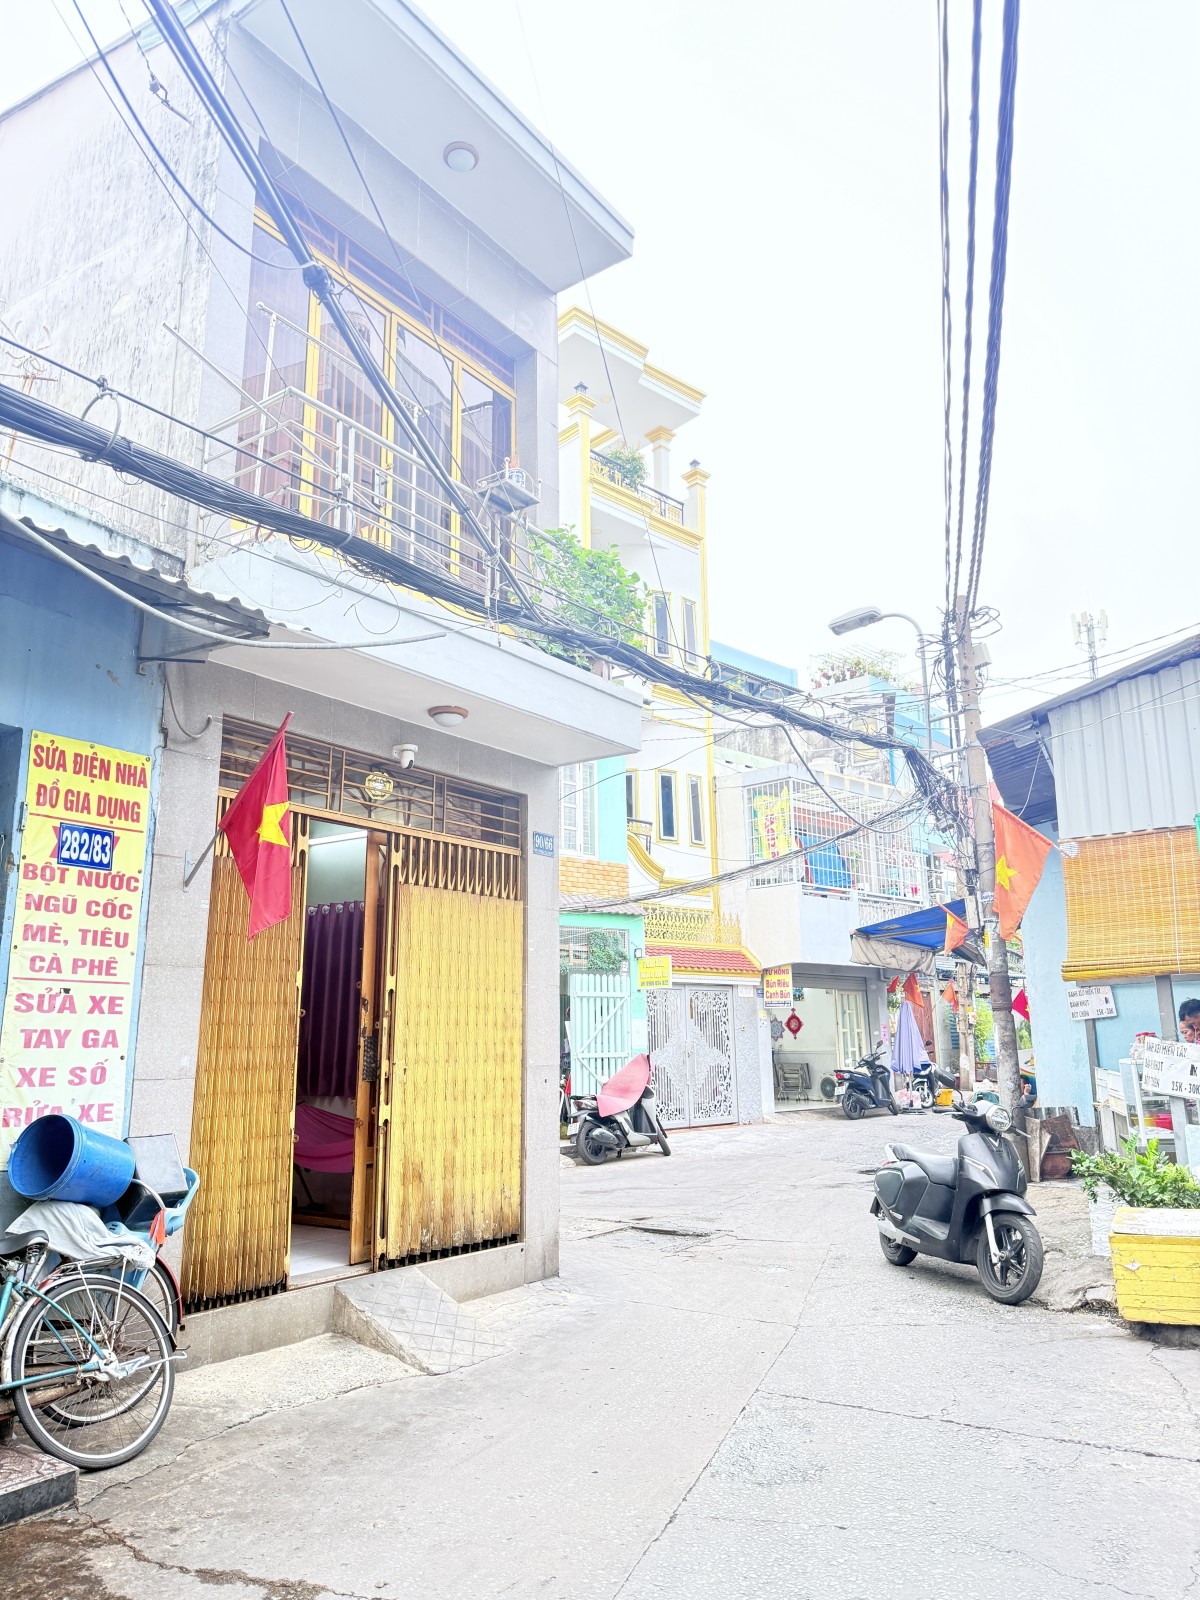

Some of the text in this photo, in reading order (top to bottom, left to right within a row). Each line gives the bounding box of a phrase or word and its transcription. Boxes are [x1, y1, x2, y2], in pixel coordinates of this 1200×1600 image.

[33, 740, 147, 788] SỬA ĐIỆN NHÀ
[36, 779, 140, 824] ĐỒ GIA DỤNG
[61, 829, 111, 864] 282/83
[23, 862, 140, 892] BỘT NƯỚC
[25, 893, 133, 920] NGŨ CỐC
[22, 922, 129, 948] MÈ, TIÊU
[29, 953, 118, 976] CÀ PHÊ
[14, 987, 124, 1015] SỬA XE
[20, 1029, 119, 1048] TAY GA
[15, 1059, 109, 1088] XE SỐ
[1171, 1081, 1183, 1092] 25K
[1188, 1083, 1200, 1095] 30K
[79, 1103, 114, 1123] XE
